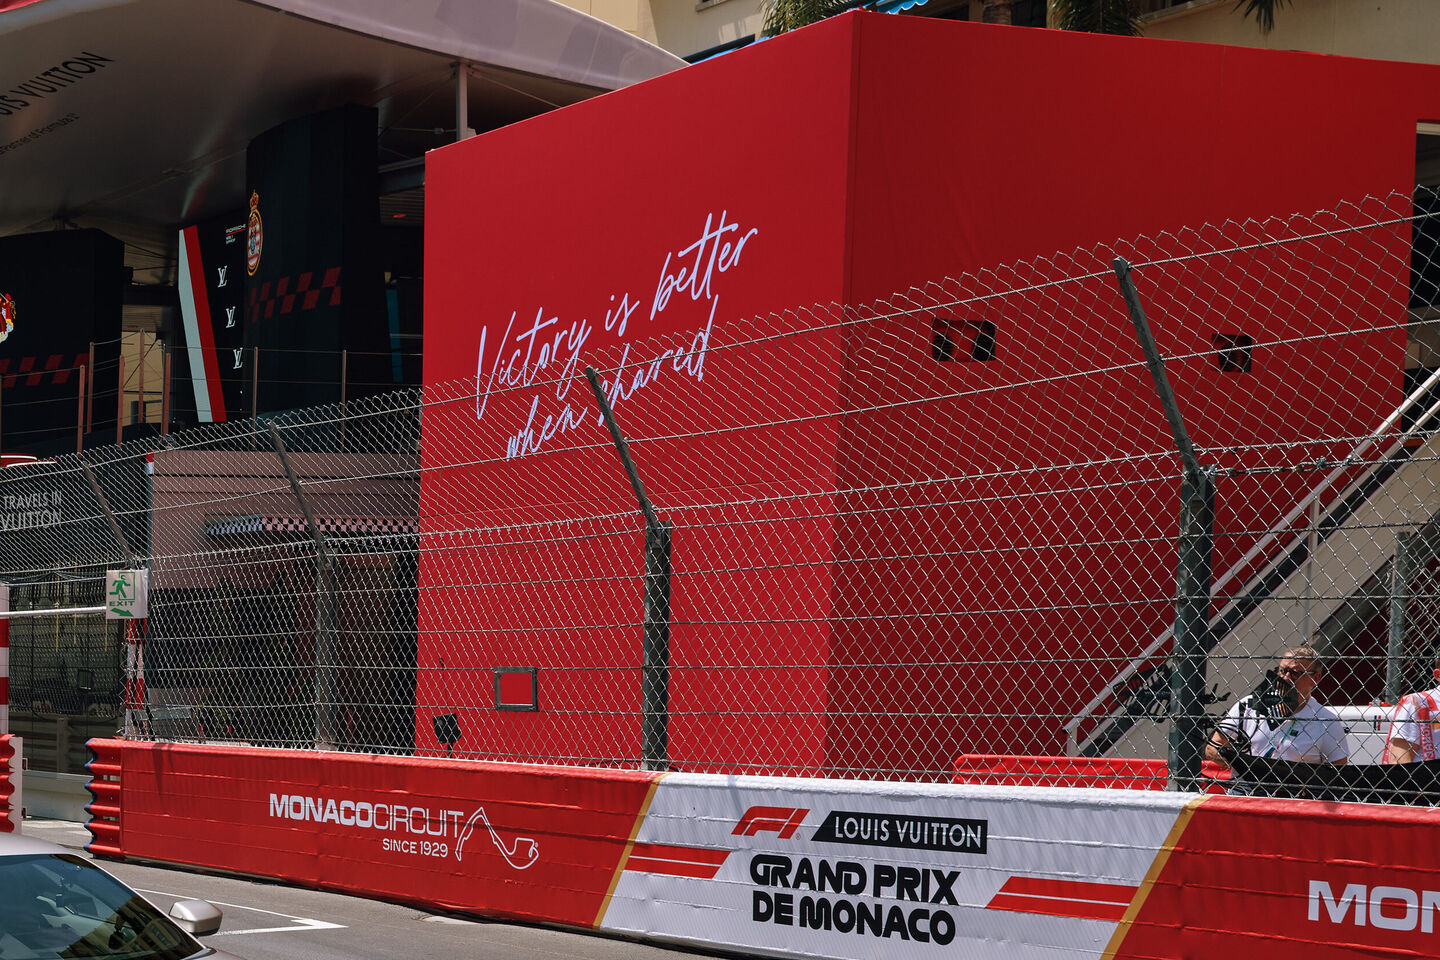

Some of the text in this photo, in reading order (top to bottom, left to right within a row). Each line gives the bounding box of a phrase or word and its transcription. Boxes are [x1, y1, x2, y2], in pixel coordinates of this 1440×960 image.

[9, 51, 115, 98] VUITTON
[476, 210, 758, 420] Victory is better
[506, 395, 588, 461] when
[0, 509, 62, 531] VUITTON
[2, 491, 48, 510] TRAVELS
[51, 489, 62, 506] IN
[383, 837, 448, 858] SINCE 1929
[835, 816, 891, 842] LOUIS
[896, 819, 982, 849] VUITTON
[750, 854, 960, 906] GRAND PRIX
[753, 890, 956, 945] DE MONACO
